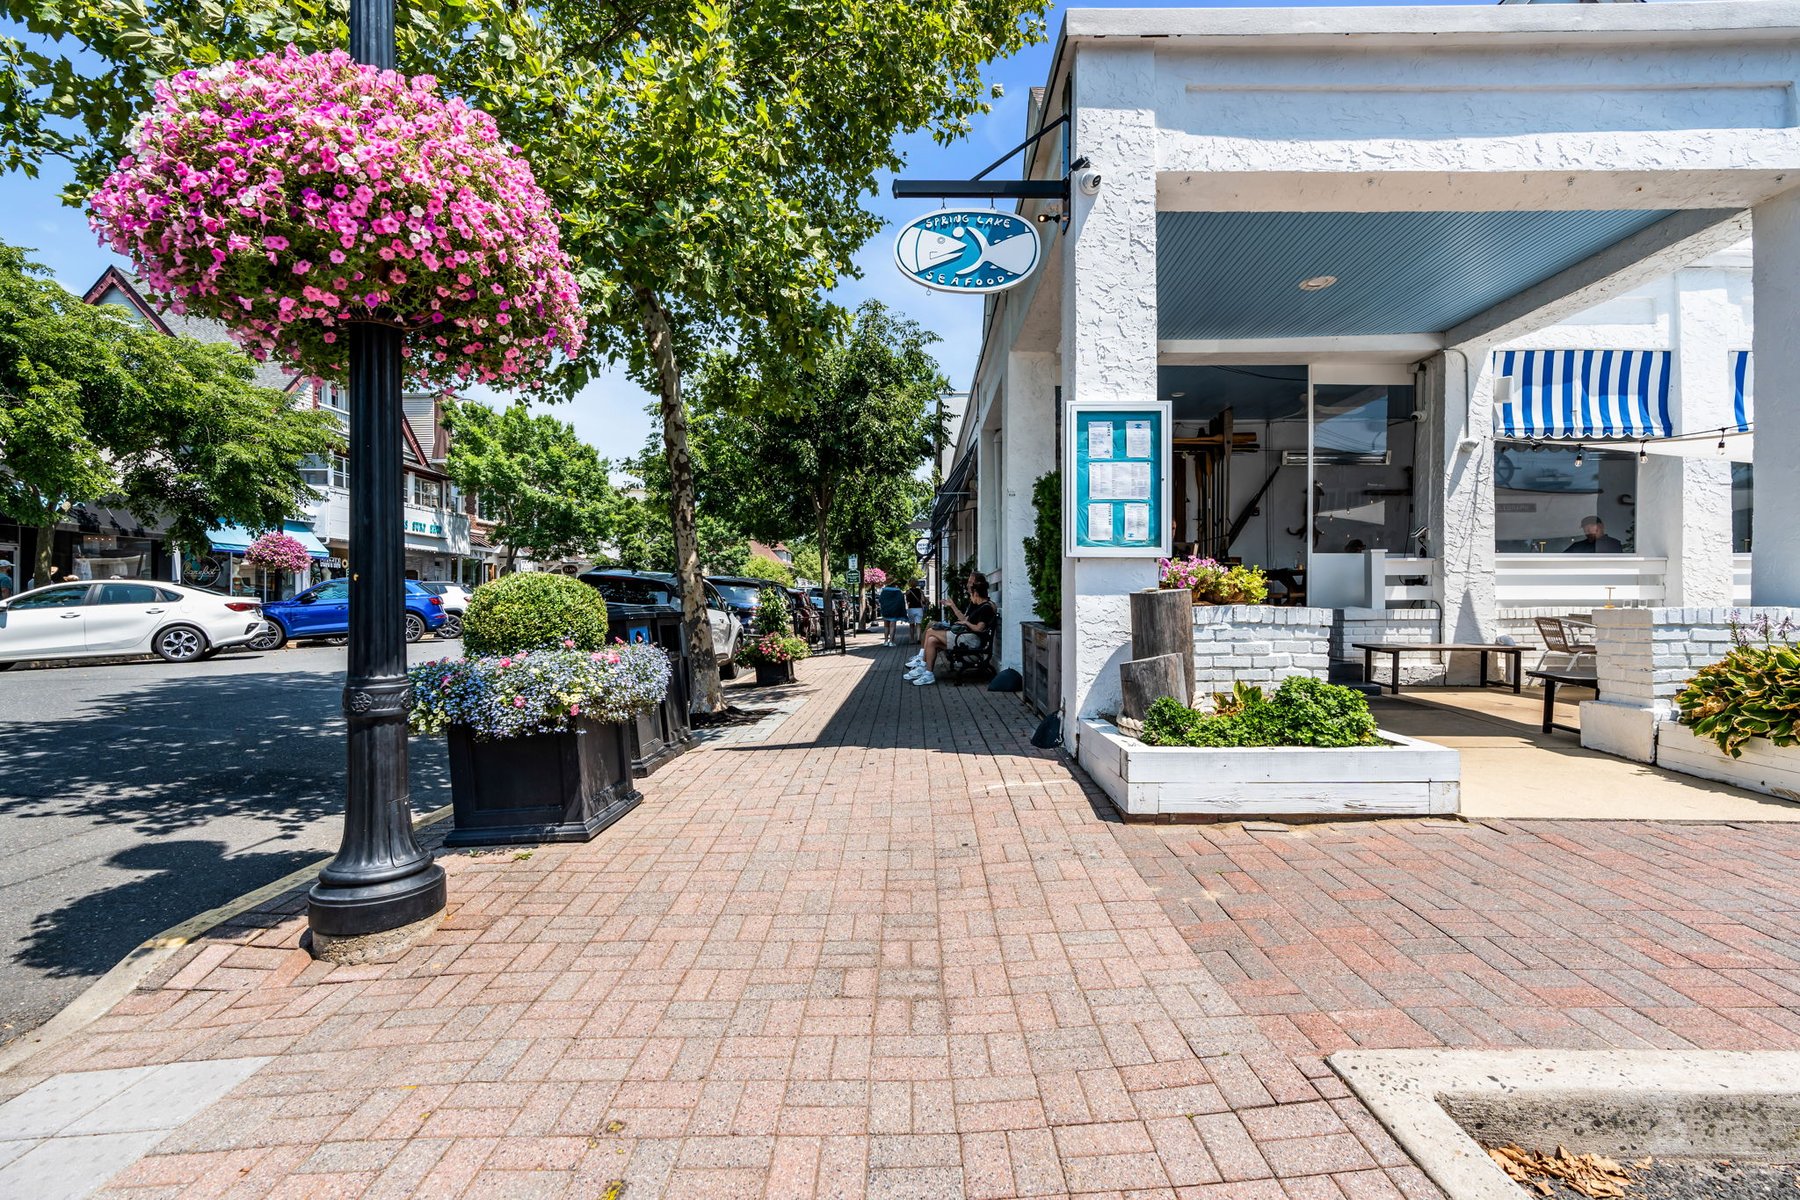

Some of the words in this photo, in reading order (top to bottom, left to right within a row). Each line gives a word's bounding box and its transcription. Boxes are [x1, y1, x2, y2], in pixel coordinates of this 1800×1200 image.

[925, 214, 969, 228] SPRING
[977, 215, 1011, 228] LAKE
[926, 271, 1005, 286] SEAFOOD
[412, 521, 426, 533] SURF
